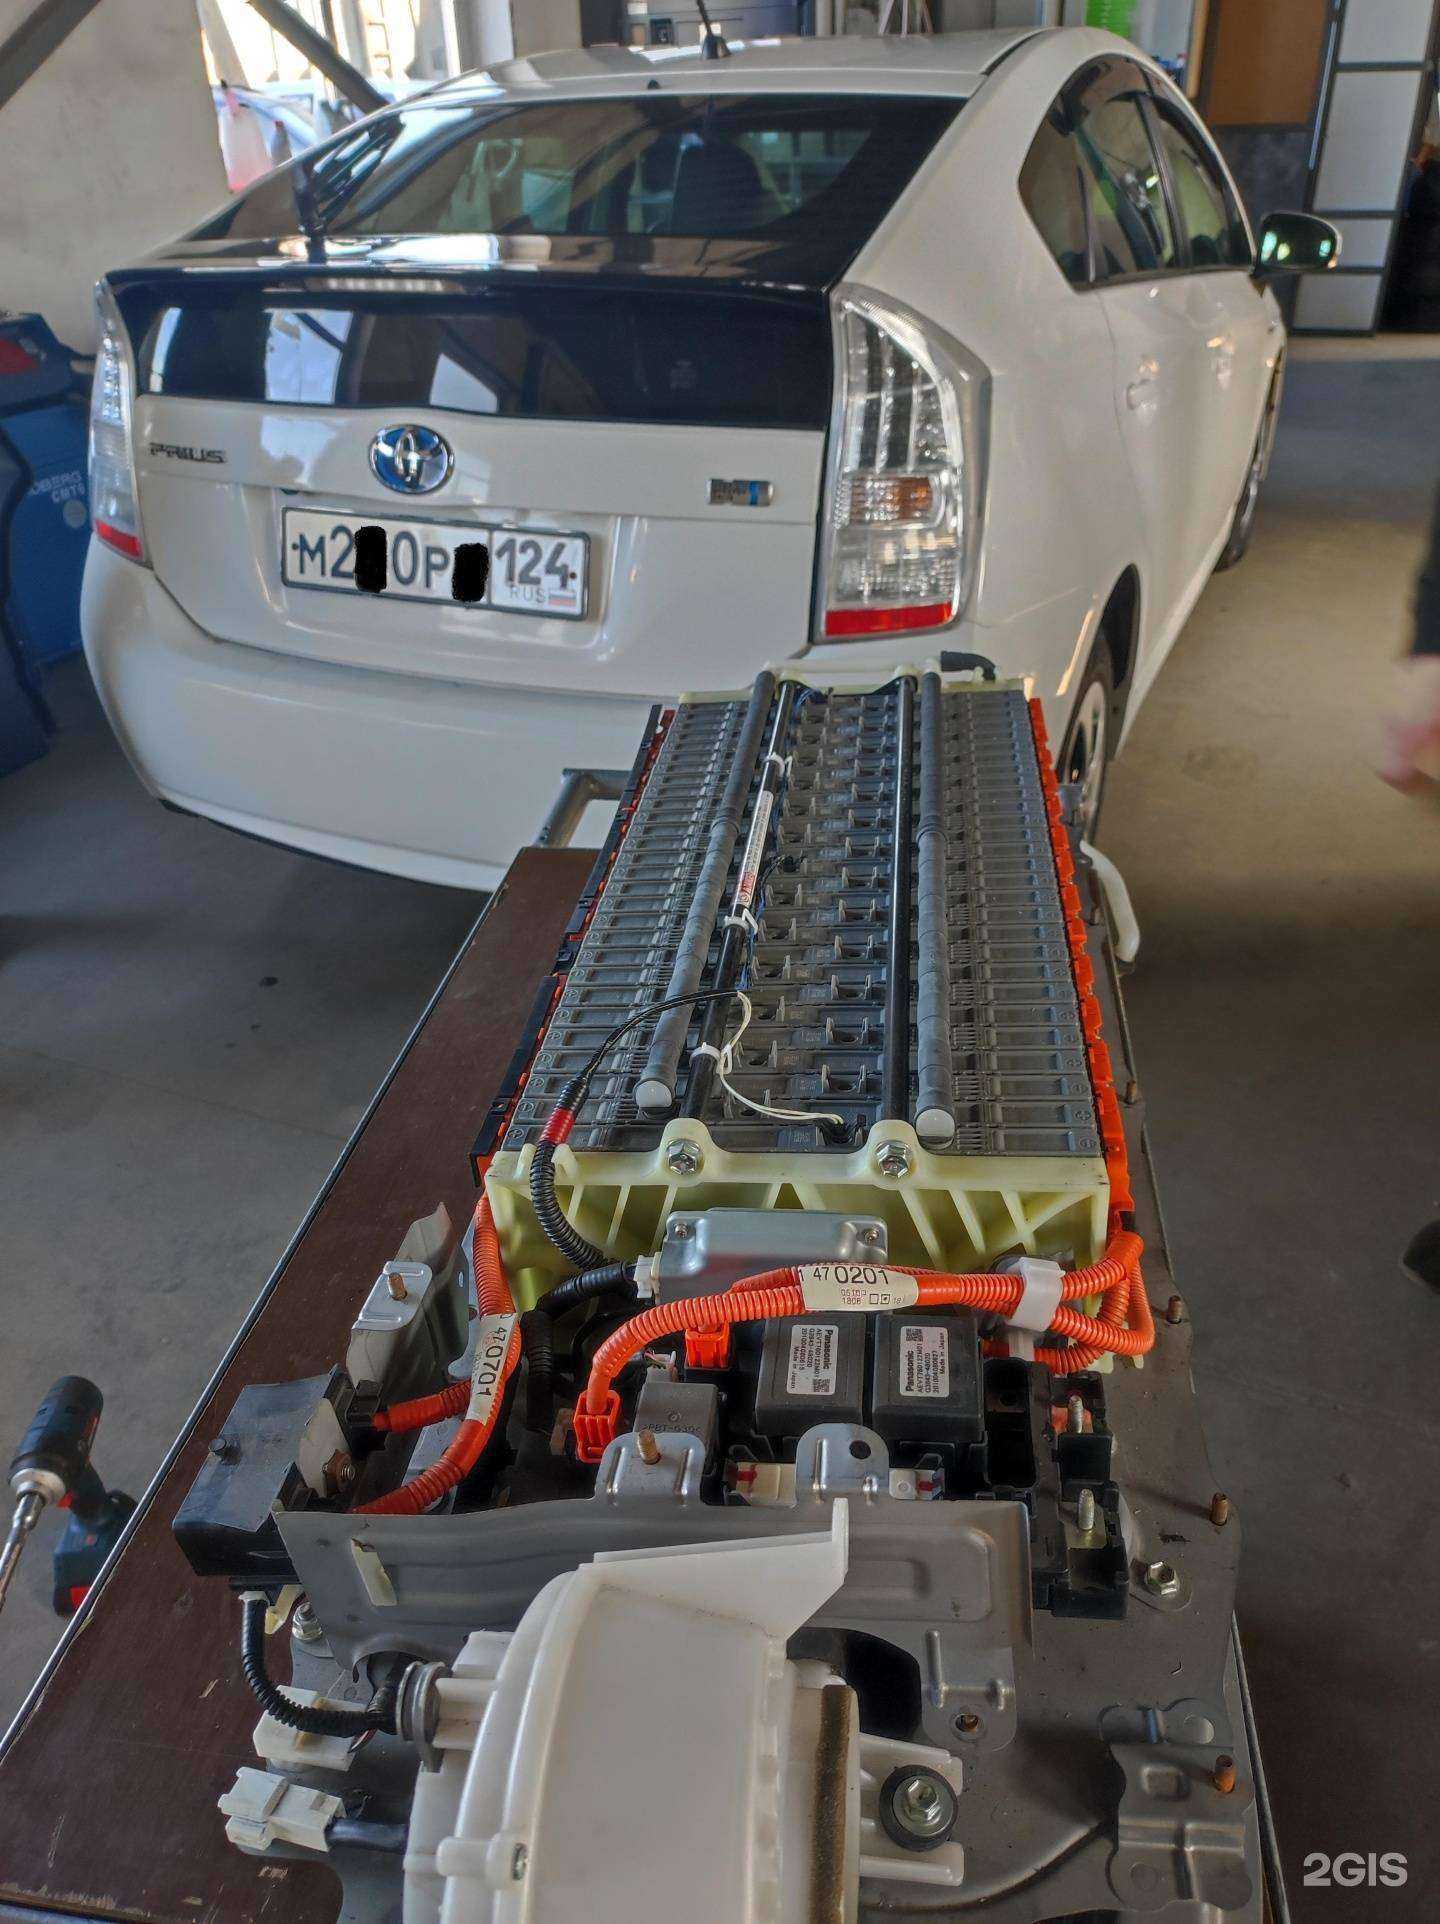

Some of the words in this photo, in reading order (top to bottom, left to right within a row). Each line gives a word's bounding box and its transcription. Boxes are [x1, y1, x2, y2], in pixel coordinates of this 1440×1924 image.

[149, 442, 227, 463] PRIUS
[495, 537, 570, 590] 124
[509, 584, 546, 603] RUS
[823, 1329, 834, 1370] Panasonic
[905, 1350, 915, 1392] Panasonic
